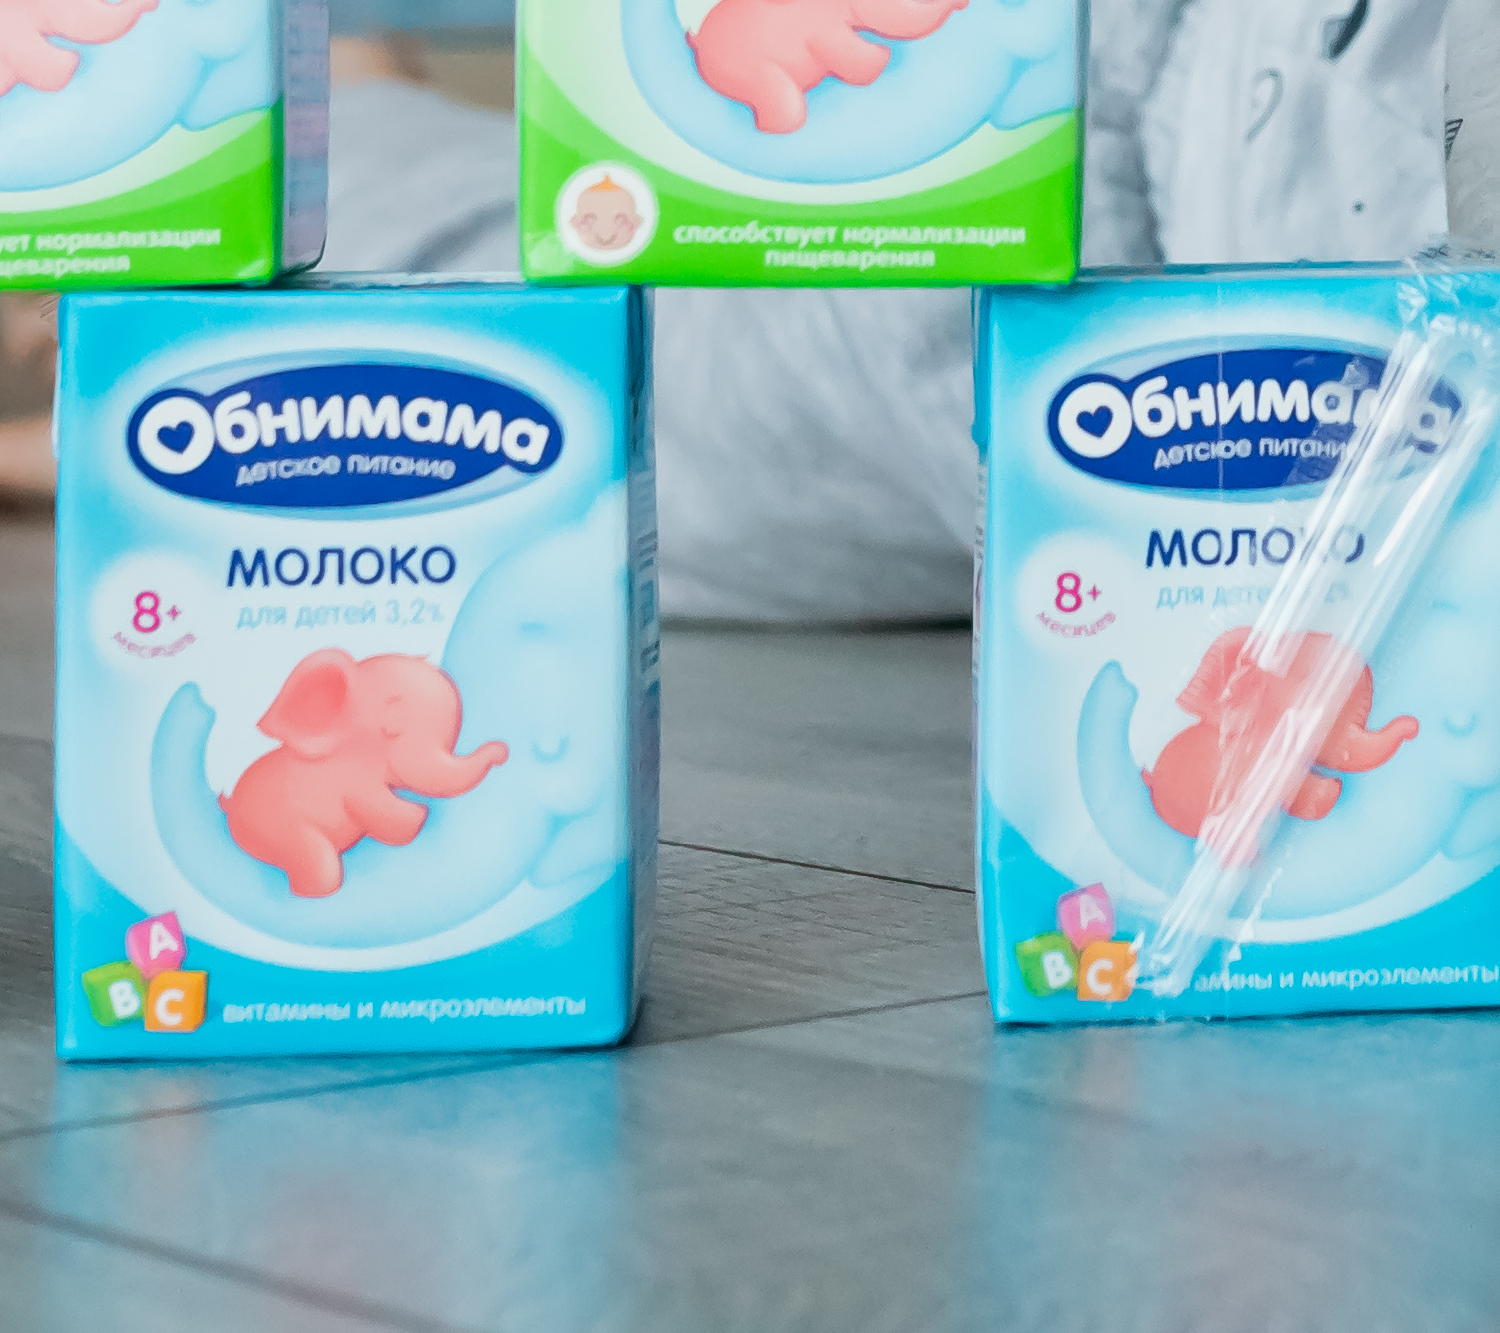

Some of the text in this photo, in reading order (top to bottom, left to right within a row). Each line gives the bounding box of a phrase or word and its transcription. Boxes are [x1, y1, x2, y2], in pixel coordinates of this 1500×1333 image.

[674, 222, 836, 247] способствует
[138, 391, 550, 474] Обнимама
[236, 455, 456, 488] детское питание
[1154, 438, 1347, 470] детское питани
[226, 546, 457, 588] МОЛОКО
[1055, 572, 1102, 613] 8+
[1156, 586, 1204, 610] для
[131, 591, 181, 633] 8+
[238, 605, 289, 630] для
[296, 602, 378, 629] детей
[1079, 894, 1106, 929] A
[147, 921, 180, 959] A
[1041, 951, 1073, 988] B
[1087, 959, 1113, 995] C
[1280, 972, 1294, 989] и
[109, 979, 139, 1017] B
[155, 990, 184, 1024] C
[357, 1002, 374, 1019] и
